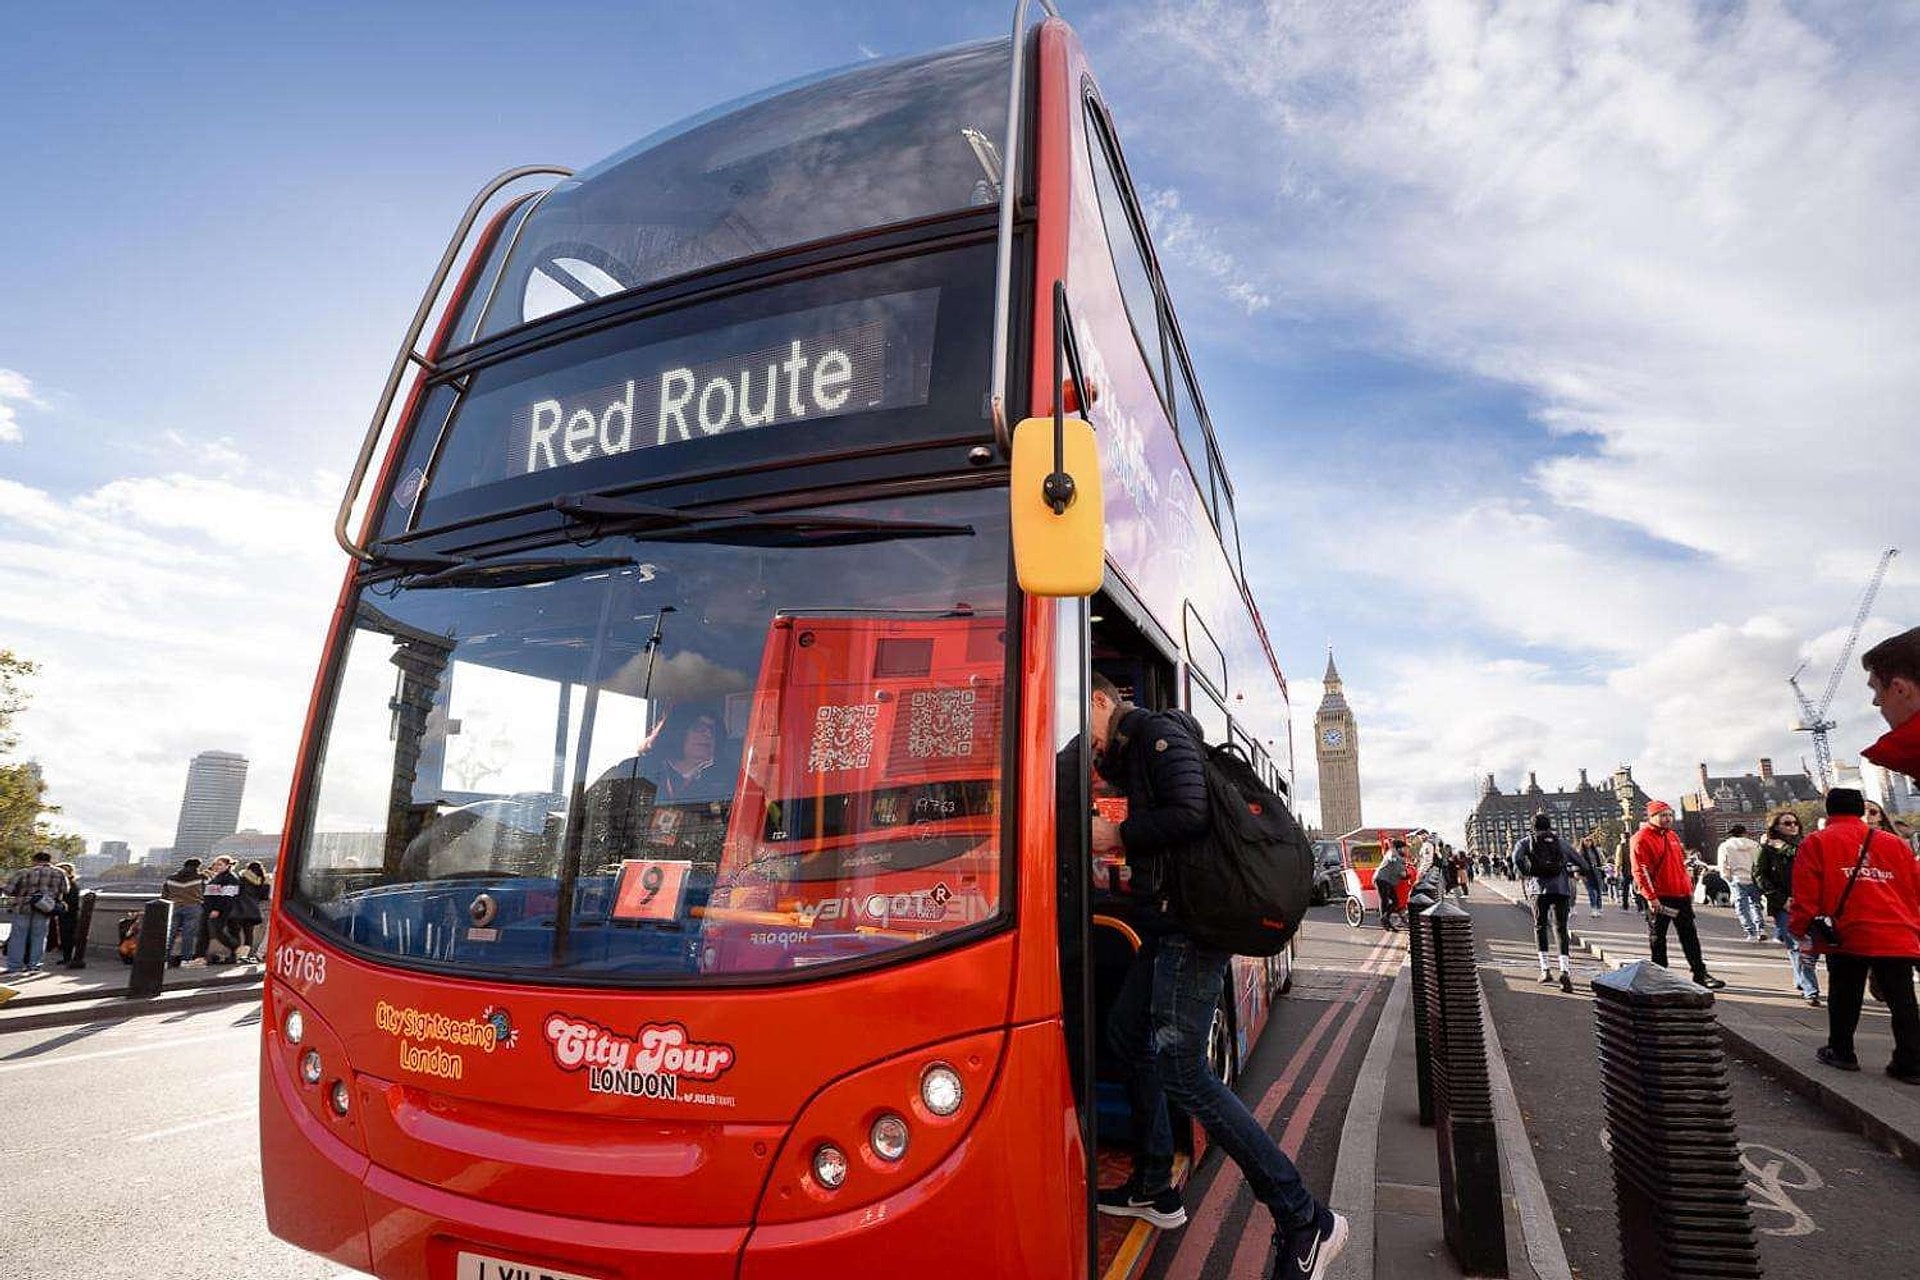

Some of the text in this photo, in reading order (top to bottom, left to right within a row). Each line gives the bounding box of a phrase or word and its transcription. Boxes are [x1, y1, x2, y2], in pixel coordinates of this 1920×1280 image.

[527, 340, 852, 472] Red Route
[642, 866, 665, 905] 9
[275, 944, 327, 985] 19763
[376, 1001, 498, 1053] City Sightseeing
[547, 1018, 730, 1074] City Tour
[400, 1039, 463, 1080] London
[590, 1066, 677, 1100] LONDON
